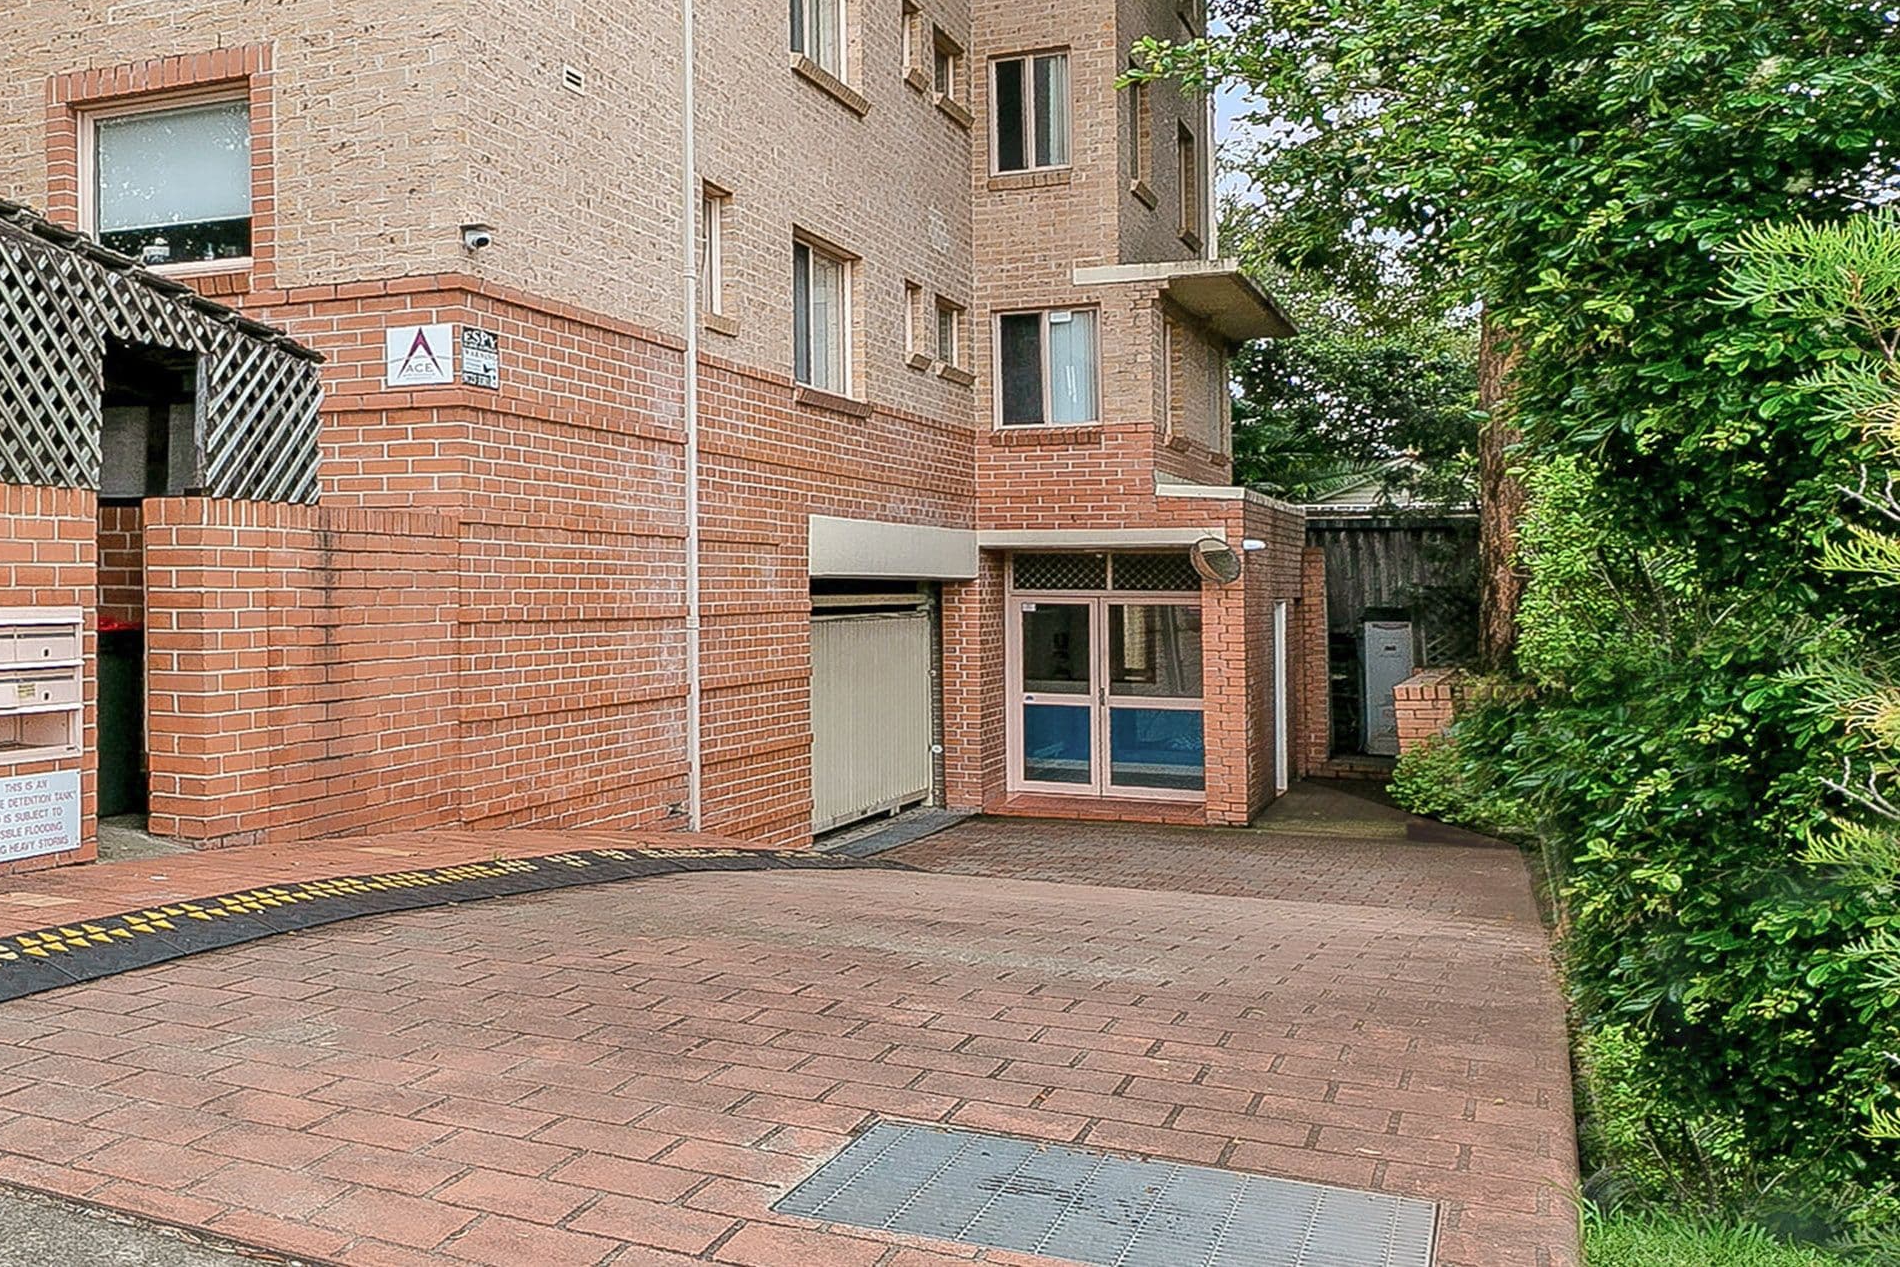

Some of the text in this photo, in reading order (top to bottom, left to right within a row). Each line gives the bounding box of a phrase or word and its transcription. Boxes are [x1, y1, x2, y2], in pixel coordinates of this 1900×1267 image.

[405, 363, 434, 373] ACE
[4, 779, 48, 793] THIS IS AN
[8, 794, 52, 808] DETENTION
[3, 813, 12, 824] IS
[15, 808, 49, 822] SUBJECT
[52, 806, 64, 817] TO
[24, 821, 63, 836] FLOODING
[9, 840, 36, 853] HEAVY
[38, 835, 69, 849] STORMS
